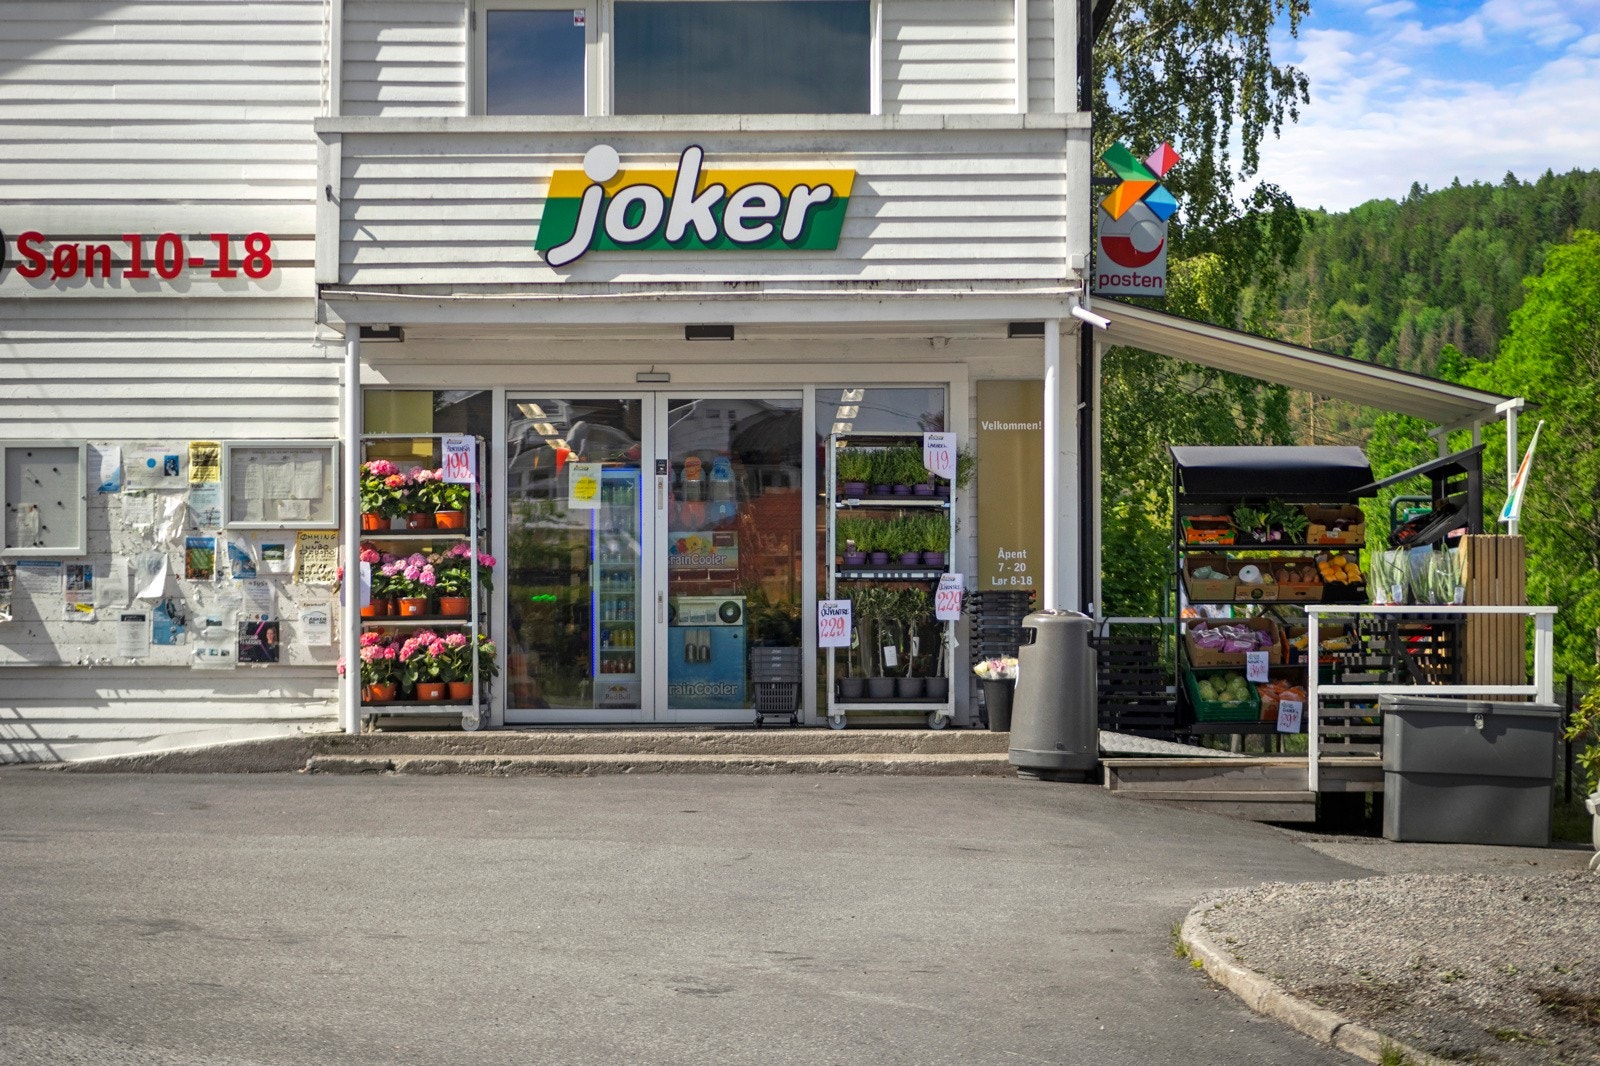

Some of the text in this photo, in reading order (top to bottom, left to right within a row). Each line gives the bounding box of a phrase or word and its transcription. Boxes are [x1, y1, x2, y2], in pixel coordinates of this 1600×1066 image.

[546, 144, 833, 268] joker
[15, 231, 273, 280] Søn 10-18
[1098, 272, 1163, 289] posten
[981, 420, 1042, 431] Velkommen!
[668, 553, 727, 566] rainCooler
[998, 547, 1027, 560] Åpent
[998, 563, 1004, 572] 7
[1014, 563, 1026, 572] 20
[992, 576, 1033, 586] Lør 8-18
[669, 682, 738, 695] rainCooler
